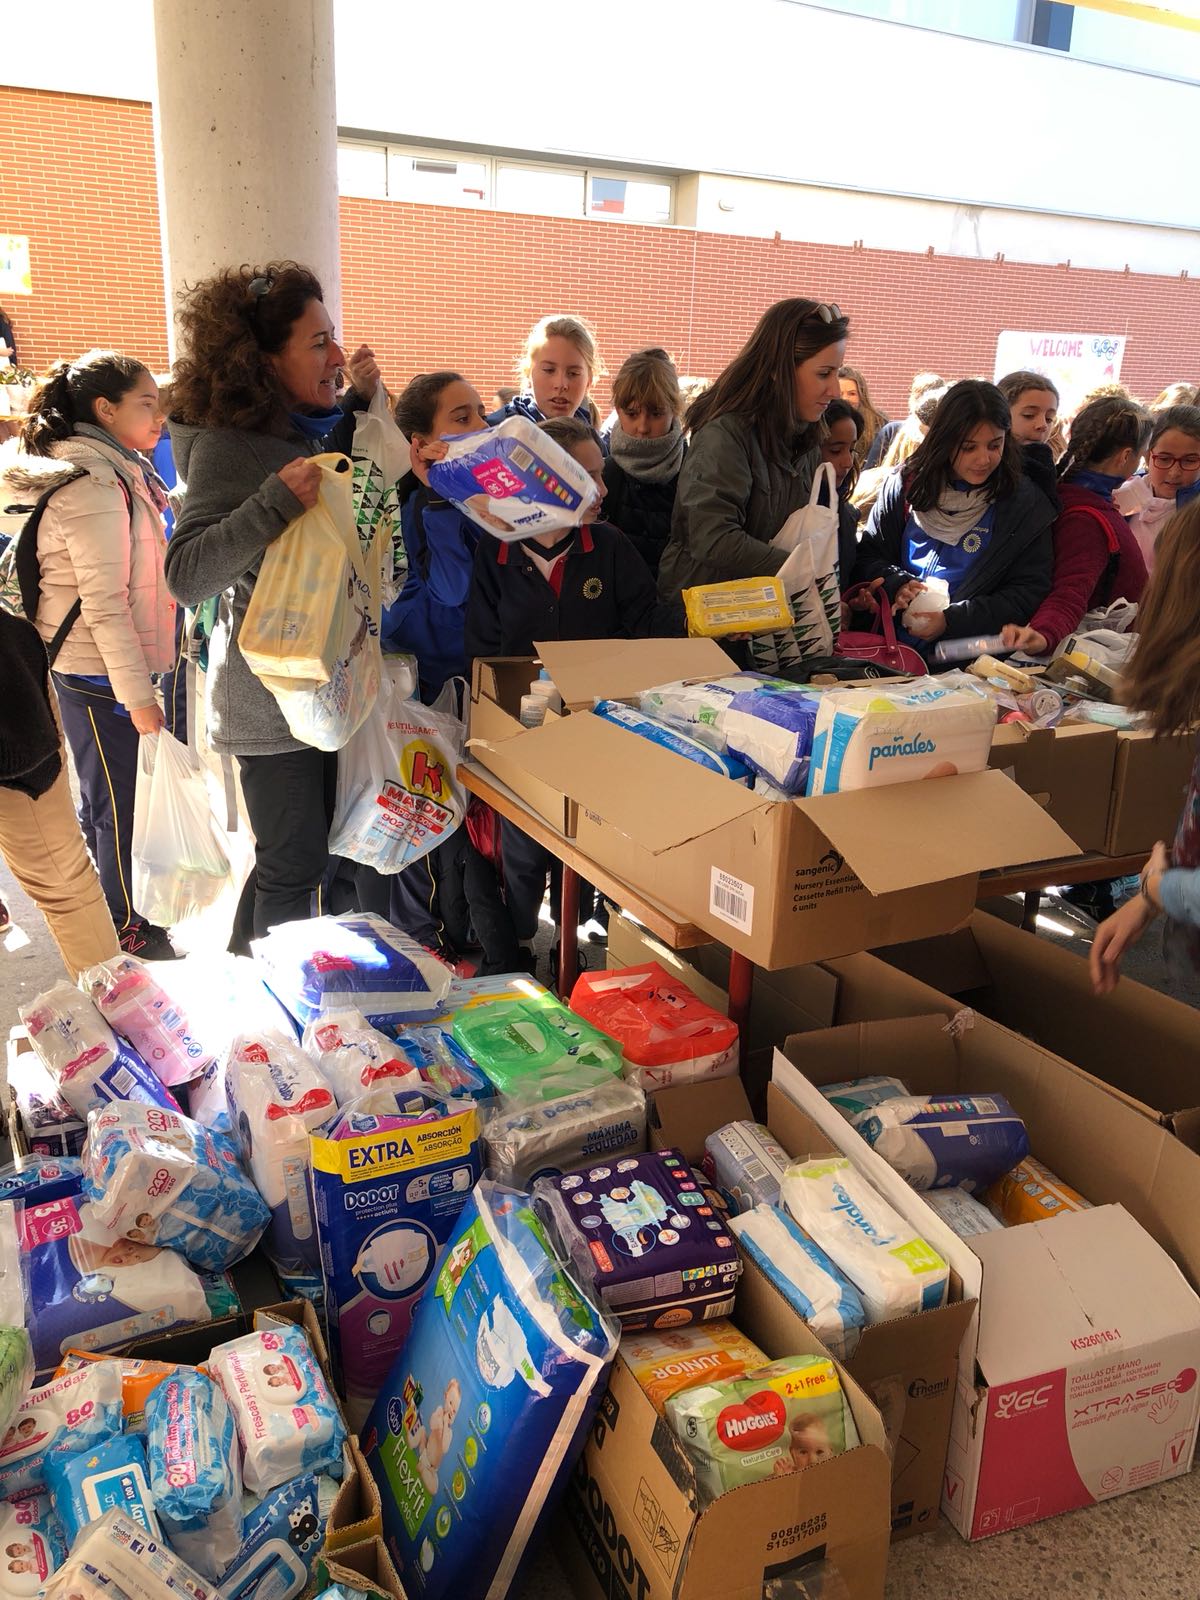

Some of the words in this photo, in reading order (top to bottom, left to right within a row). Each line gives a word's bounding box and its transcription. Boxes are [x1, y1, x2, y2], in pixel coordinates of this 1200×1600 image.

[1030, 338, 1083, 358] WELCOME
[869, 732, 936, 770] pañales
[381, 812, 404, 829] 902
[795, 863, 836, 878] sangenic
[793, 890, 824, 902] Cassette
[826, 886, 844, 898] Refill
[845, 882, 864, 896] Triple
[794, 880, 824, 892] Nursery
[792, 904, 798, 912] 6
[798, 902, 817, 912] units
[149, 1108, 168, 1133] 240
[586, 1120, 632, 1143] MÁXIMA
[416, 1124, 462, 1143] ABSORCIÓN
[423, 1138, 463, 1152] ABSORÇÃO
[582, 1129, 638, 1156] SEQUEDAD
[350, 1138, 414, 1169] EXTRA
[148, 1168, 170, 1197] 240
[344, 1183, 400, 1211] DODOT
[356, 1205, 385, 1216] protection
[386, 1202, 398, 1212] plus
[34, 1203, 62, 1218] 3
[374, 1208, 398, 1218] activity
[50, 1218, 68, 1234] 36
[652, 1354, 722, 1380] JUNIOR
[1072, 1370, 1104, 1384] TOALLAS
[1106, 1366, 1116, 1375] DE
[1117, 1358, 1142, 1372] MANO
[785, 1380, 805, 1395] 2+1
[806, 1373, 826, 1388] Free
[66, 1400, 95, 1426] 80
[247, 1399, 266, 1440] Frescas
[724, 1411, 778, 1439] HUGGIES
[742, 1451, 766, 1466] Natural
[766, 1447, 782, 1460] Care
[1170, 1440, 1186, 1464] V
[167, 1462, 188, 1487] 80
[392, 1437, 426, 1519] FlexFit
[131, 1502, 148, 1530] aby
[770, 1512, 828, 1541] 90888235
[766, 1521, 828, 1552] S15317099
